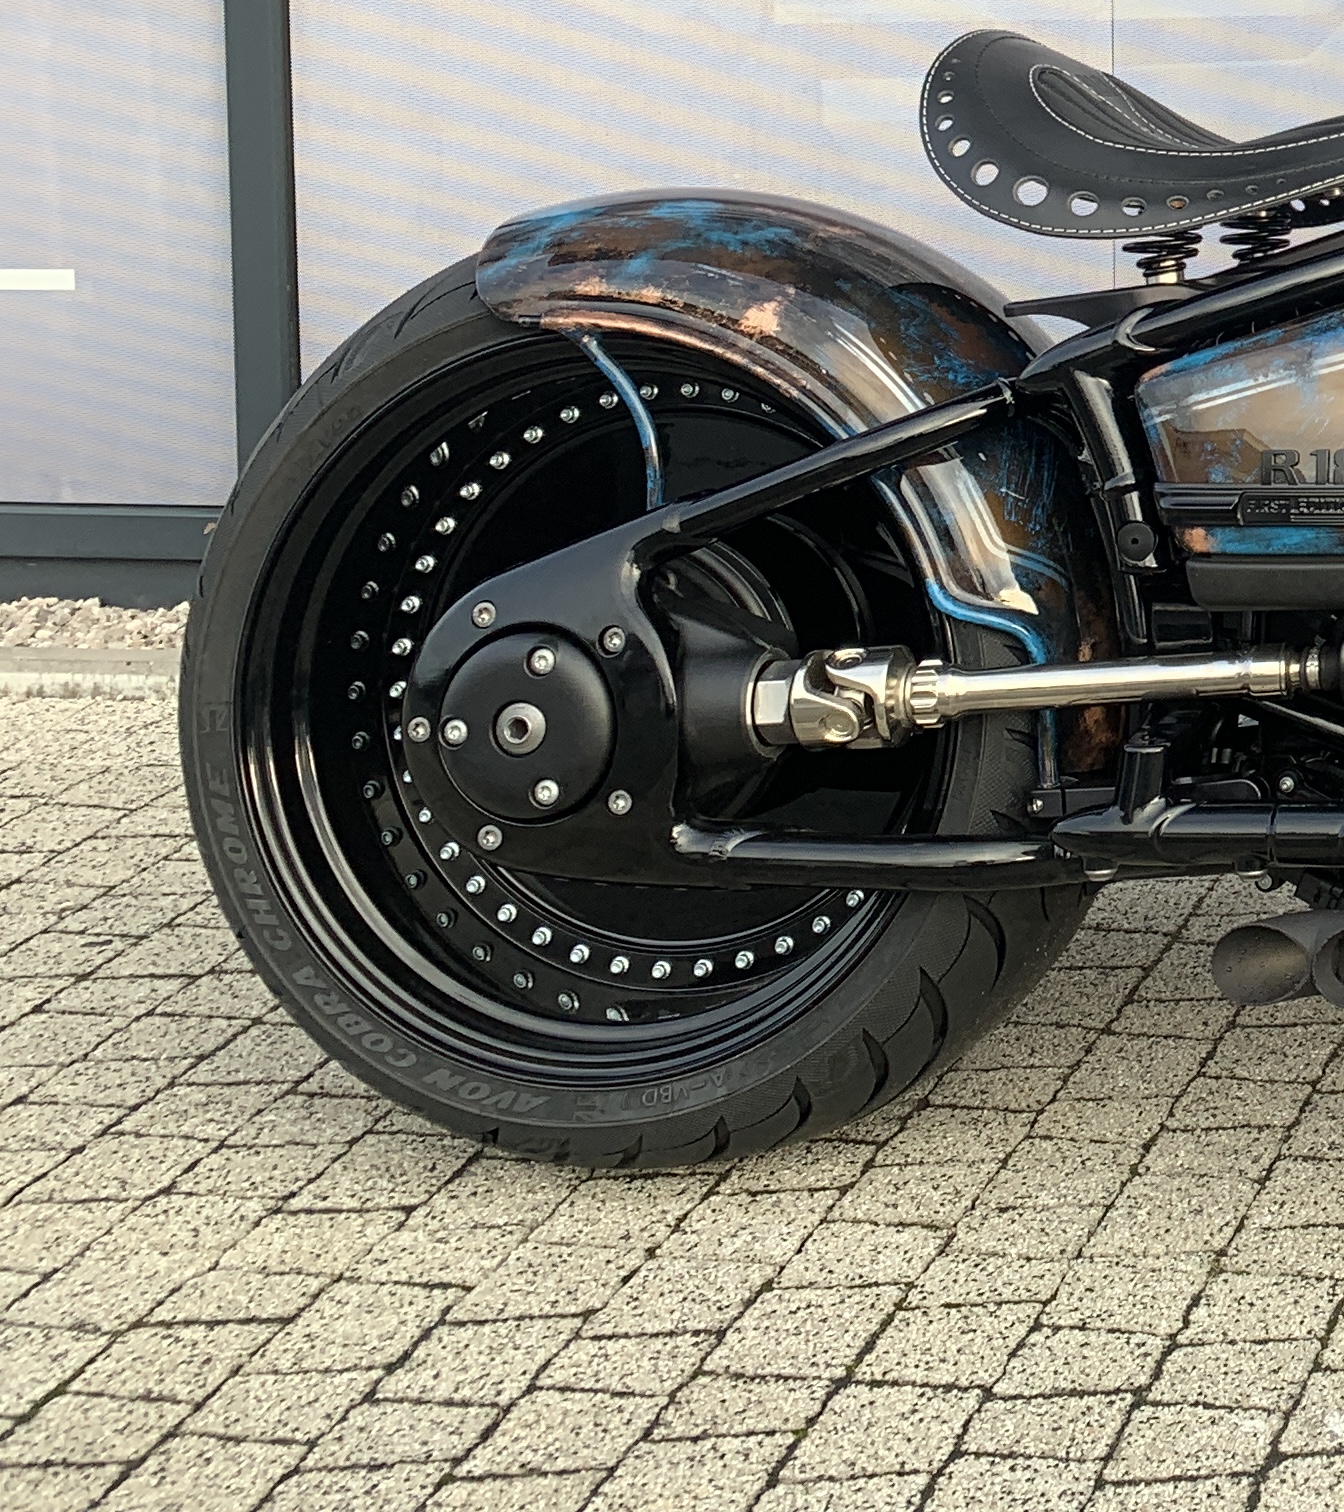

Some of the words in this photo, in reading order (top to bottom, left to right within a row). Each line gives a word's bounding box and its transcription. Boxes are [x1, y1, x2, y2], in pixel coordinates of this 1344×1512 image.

[1261, 449, 1300, 486] R
[1246, 499, 1290, 514] FIRST
[205, 763, 294, 955] CHROME
[292, 965, 420, 1068] COBRA
[423, 1069, 551, 1113] AVON
